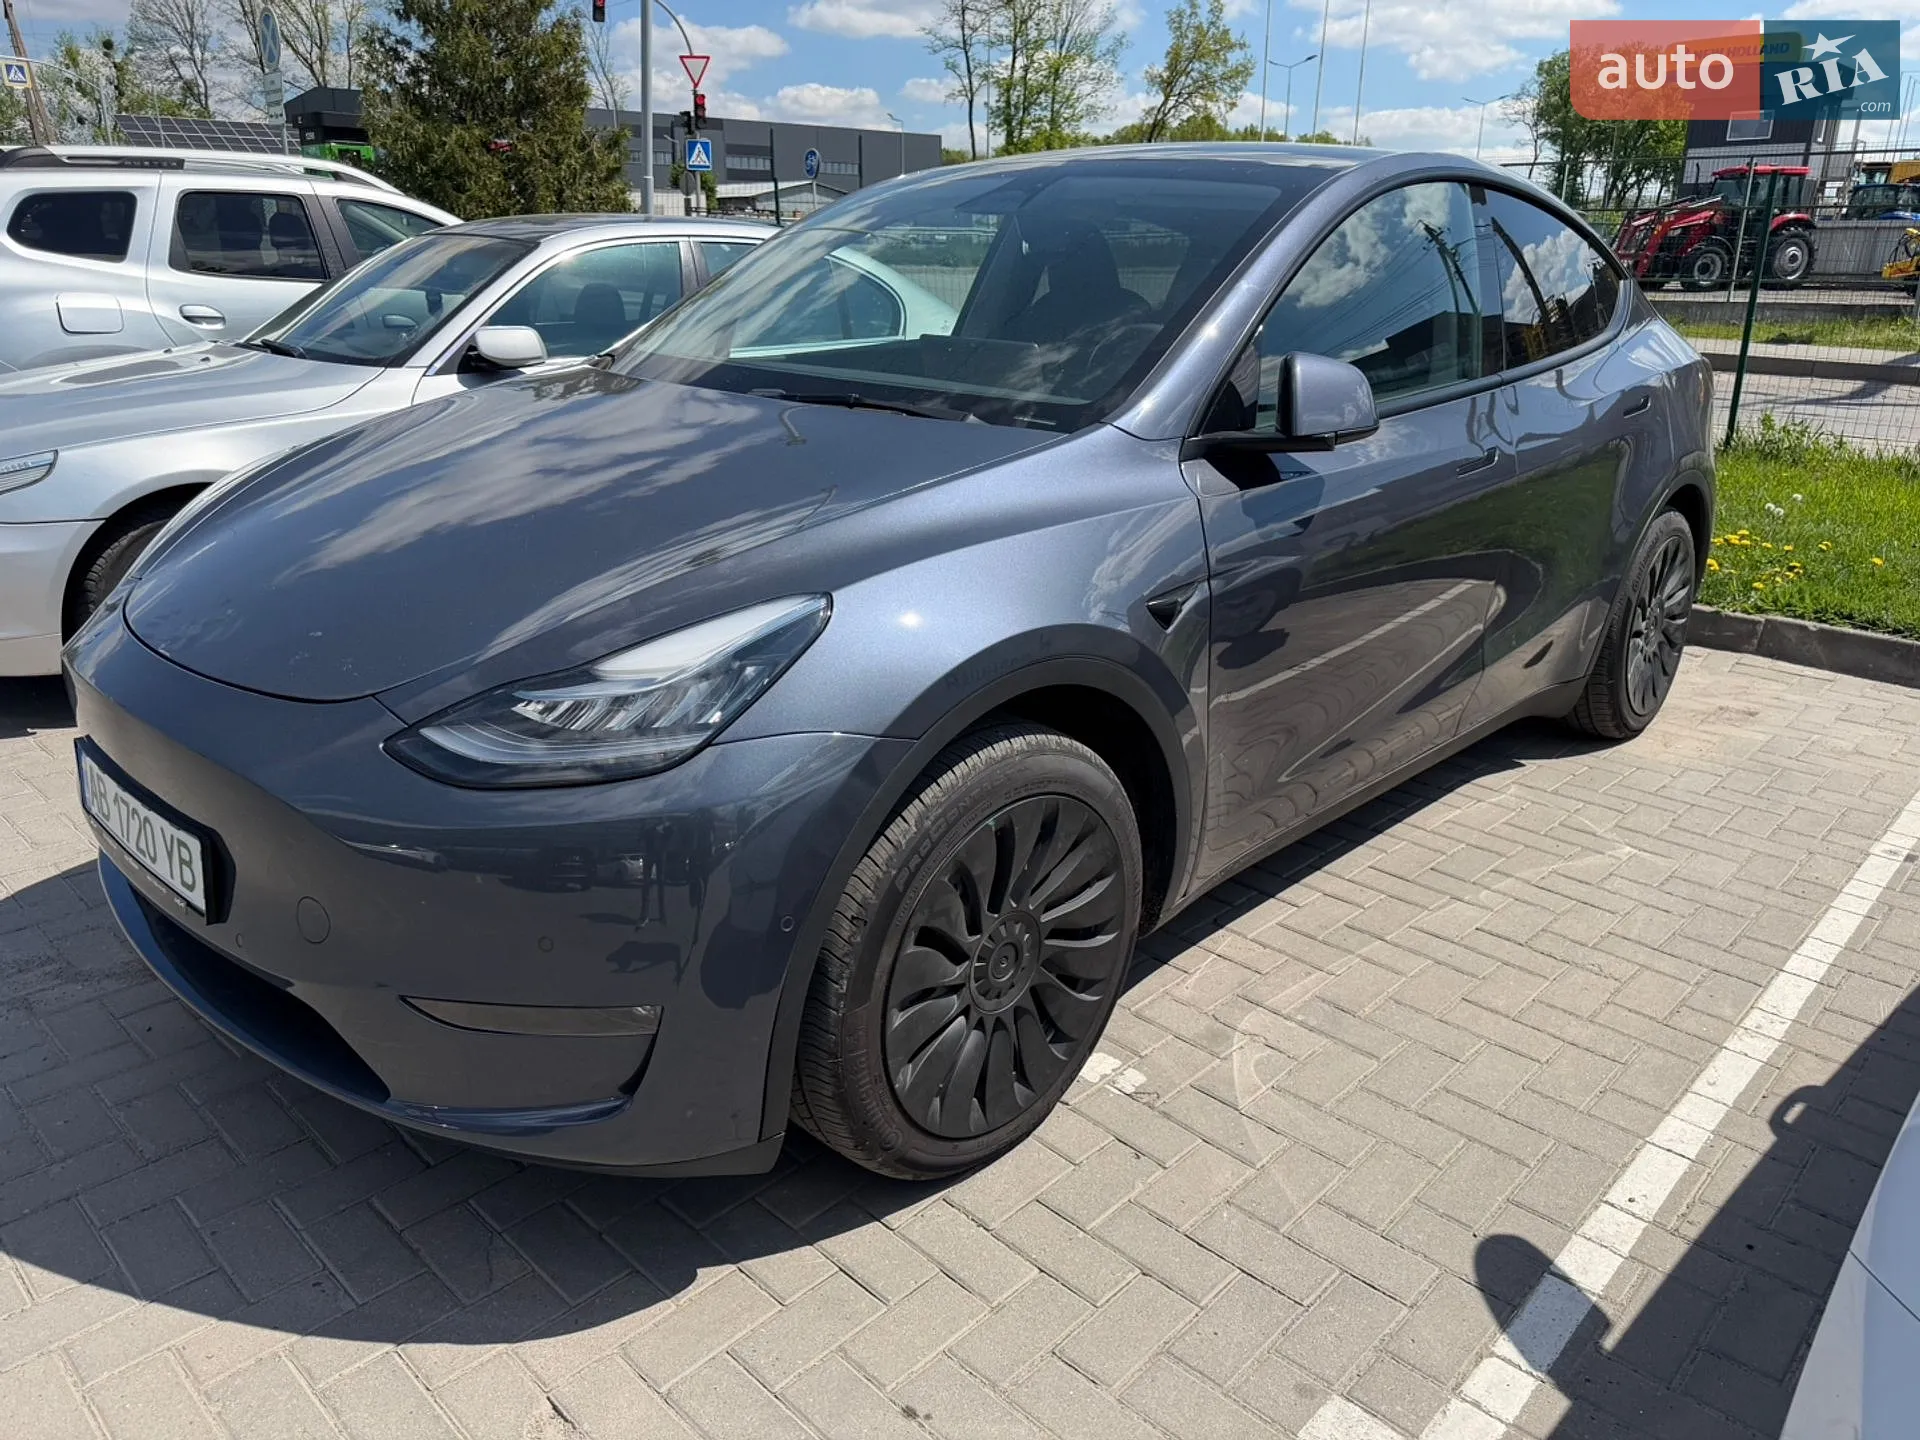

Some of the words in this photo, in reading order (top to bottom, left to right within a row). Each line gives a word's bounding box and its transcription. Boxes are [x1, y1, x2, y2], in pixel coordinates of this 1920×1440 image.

[1726, 42, 1790, 57] HOLLAND
[89, 763, 111, 822] AB
[113, 792, 157, 865] 1720
[160, 826, 196, 893] YB
